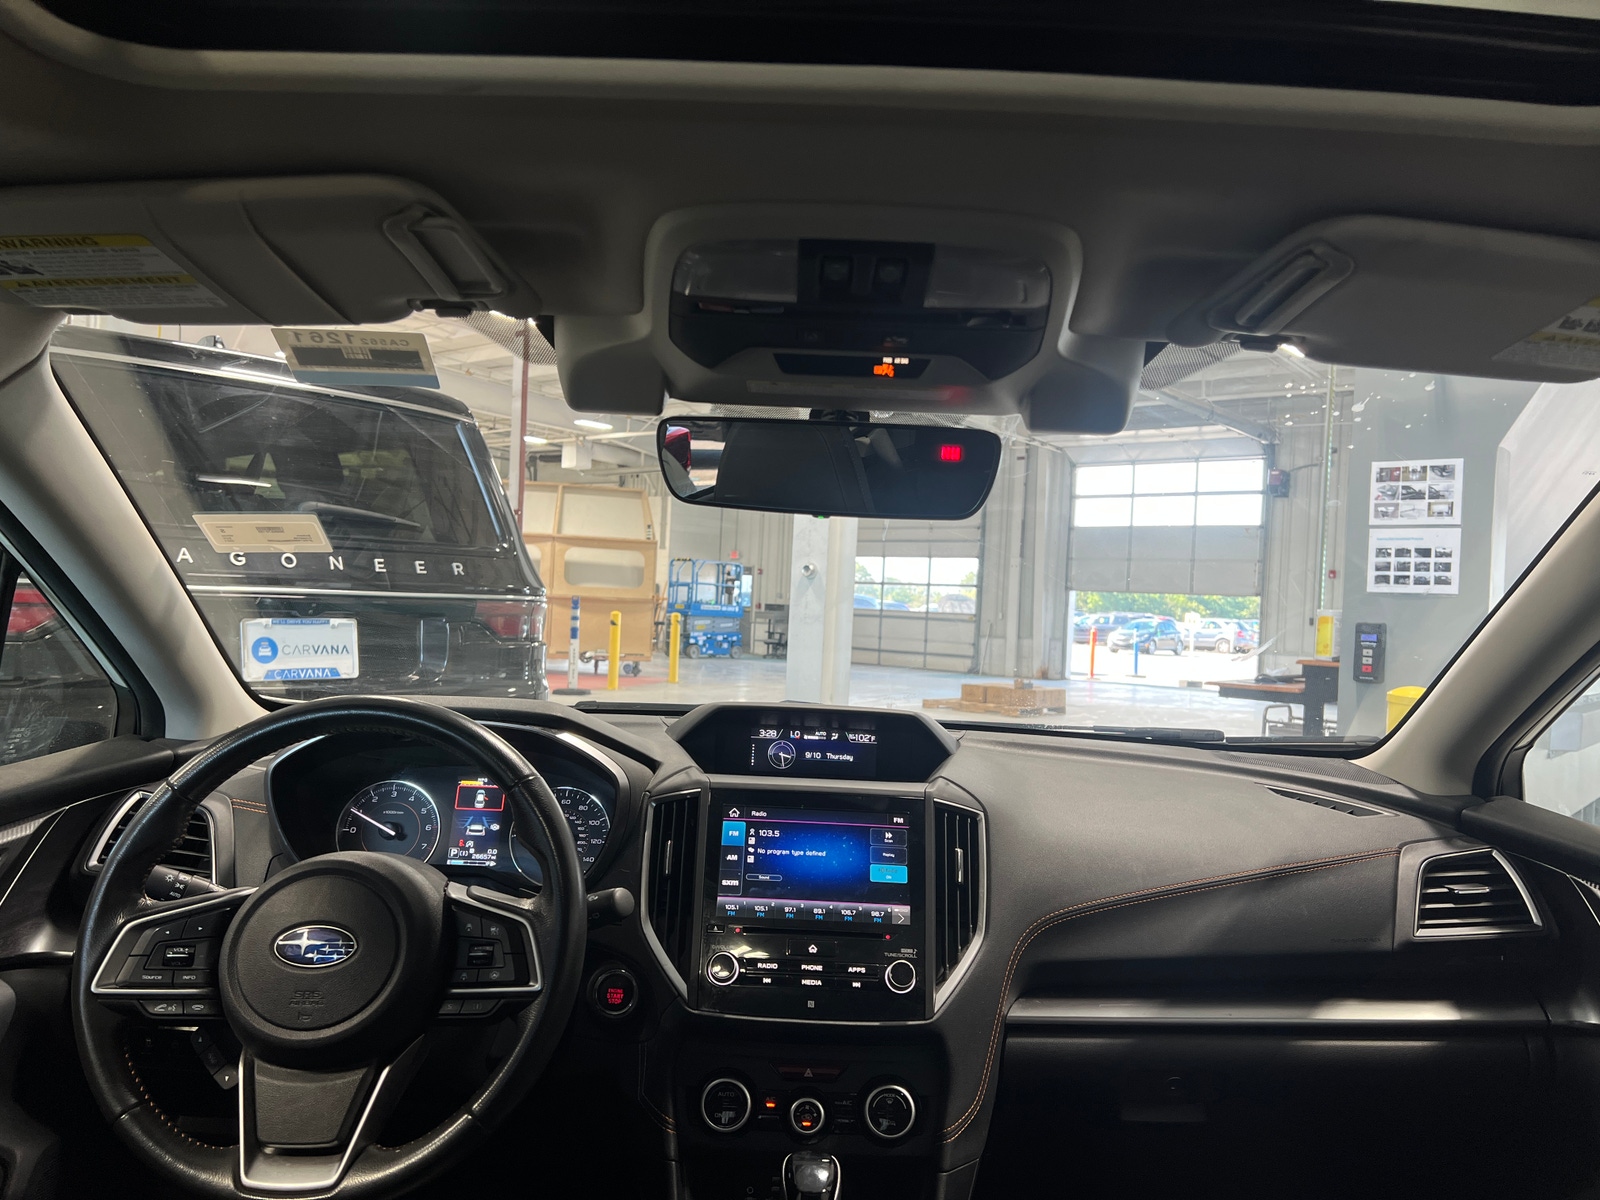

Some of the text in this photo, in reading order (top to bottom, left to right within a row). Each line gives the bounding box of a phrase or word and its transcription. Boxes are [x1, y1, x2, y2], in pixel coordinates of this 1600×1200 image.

[0, 236, 99, 249] WARNING
[33, 275, 182, 288] AVERTISSEMENT
[281, 644, 350, 656] CARVANA
[274, 668, 332, 679] CARVANA
[759, 729, 777, 738] 3:28
[826, 753, 854, 762] Thursday
[391, 790, 398, 798] 3
[421, 807, 427, 815] 5
[349, 826, 357, 834] 0
[758, 829, 780, 838] 103.5
[450, 848, 458, 857] P
[766, 848, 790, 857] program
[791, 849, 804, 857] type
[805, 849, 826, 857] defined
[757, 962, 778, 970] RADIO
[801, 964, 823, 972] PHONE
[848, 966, 866, 974] APPS
